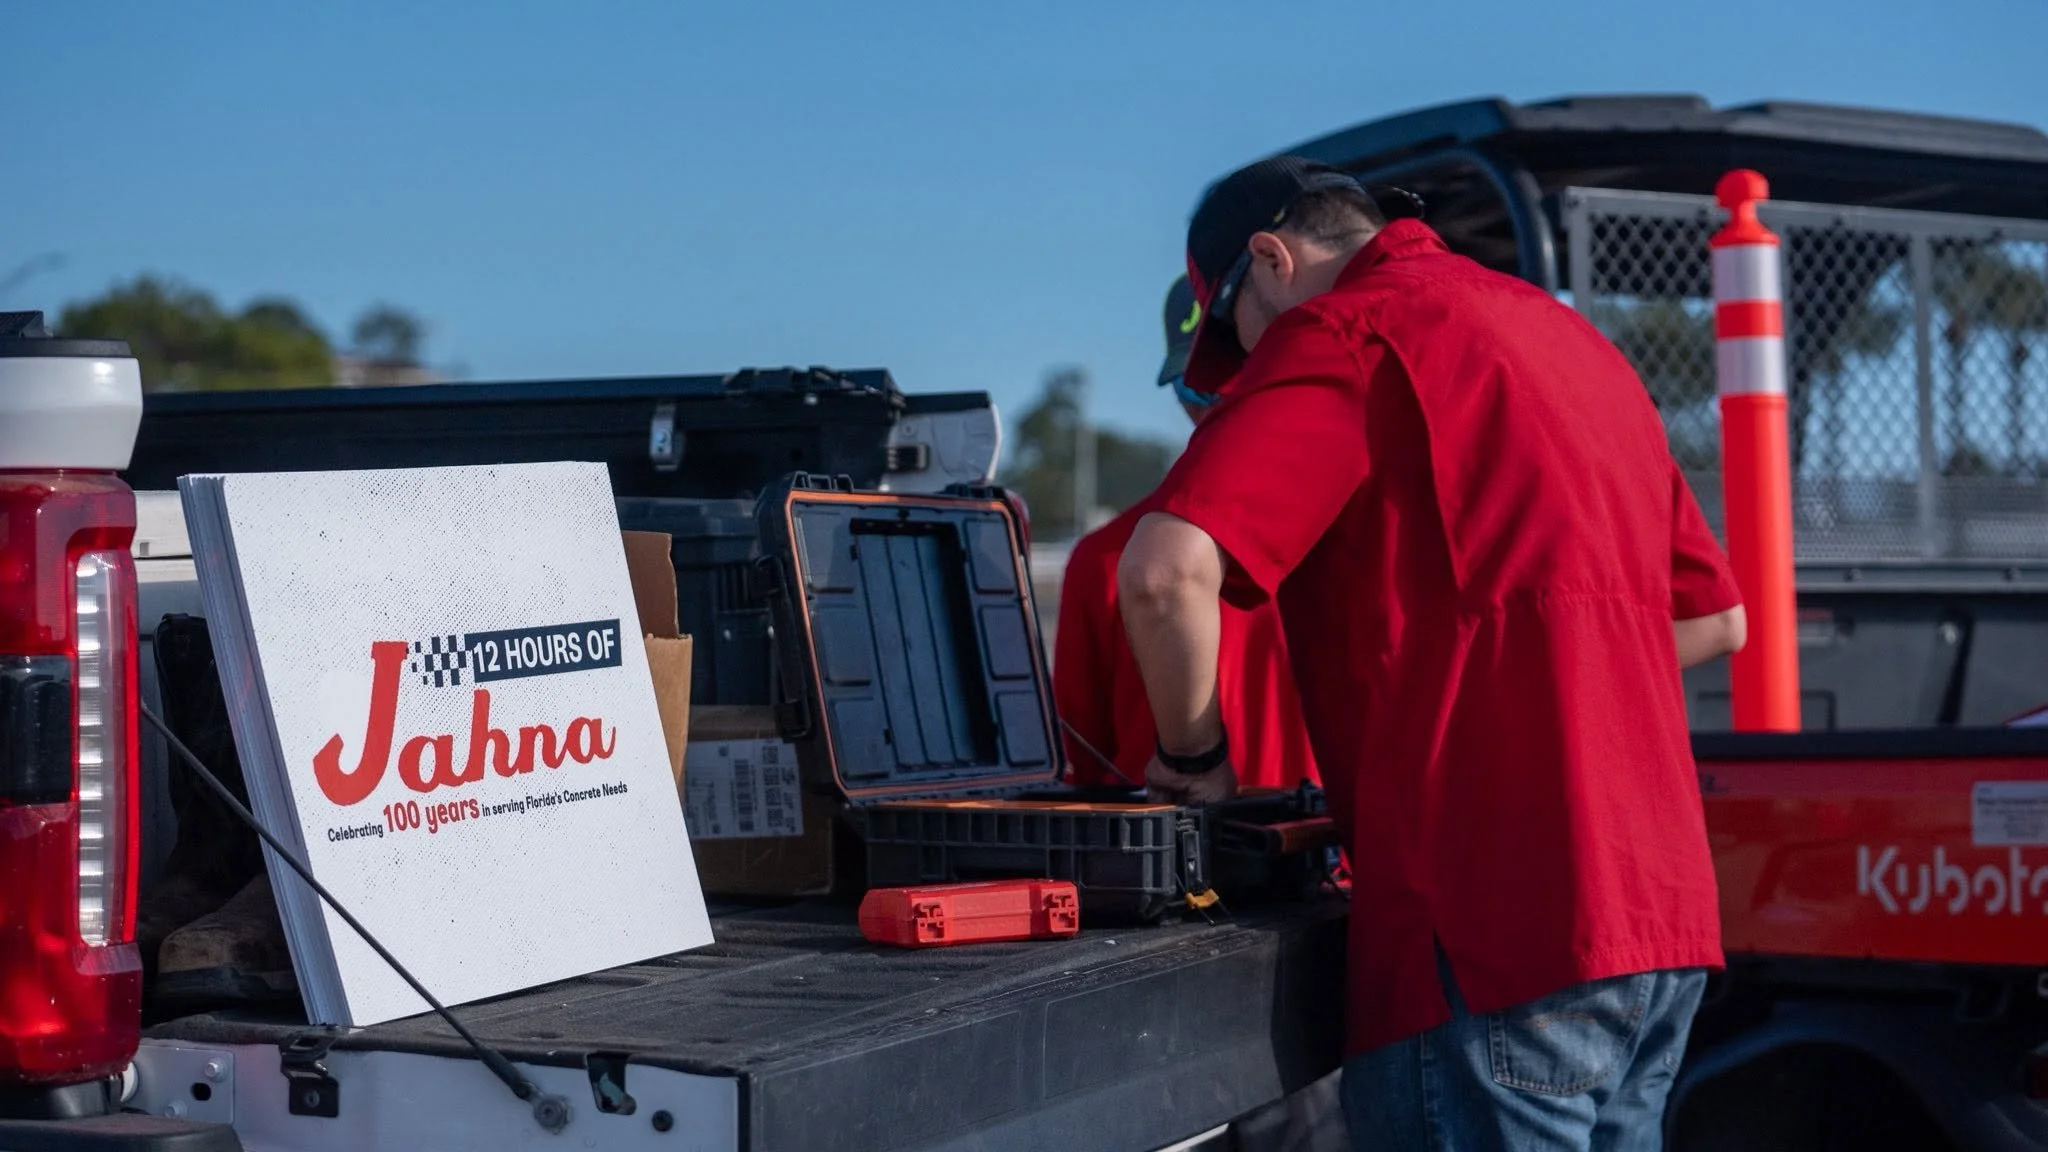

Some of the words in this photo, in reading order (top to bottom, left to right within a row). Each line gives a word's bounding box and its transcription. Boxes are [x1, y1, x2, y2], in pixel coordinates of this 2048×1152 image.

[474, 641, 500, 673] 12
[504, 632, 583, 669] HOURS
[587, 628, 615, 661] OF
[313, 640, 616, 806] Jahna
[327, 822, 384, 842] Celebrating
[383, 800, 420, 832] 100
[425, 798, 480, 834] years
[481, 803, 491, 817] in
[492, 798, 525, 814] serving
[525, 793, 562, 810] Florida's
[563, 788, 601, 803] Concrete
[602, 781, 628, 797] Needs
